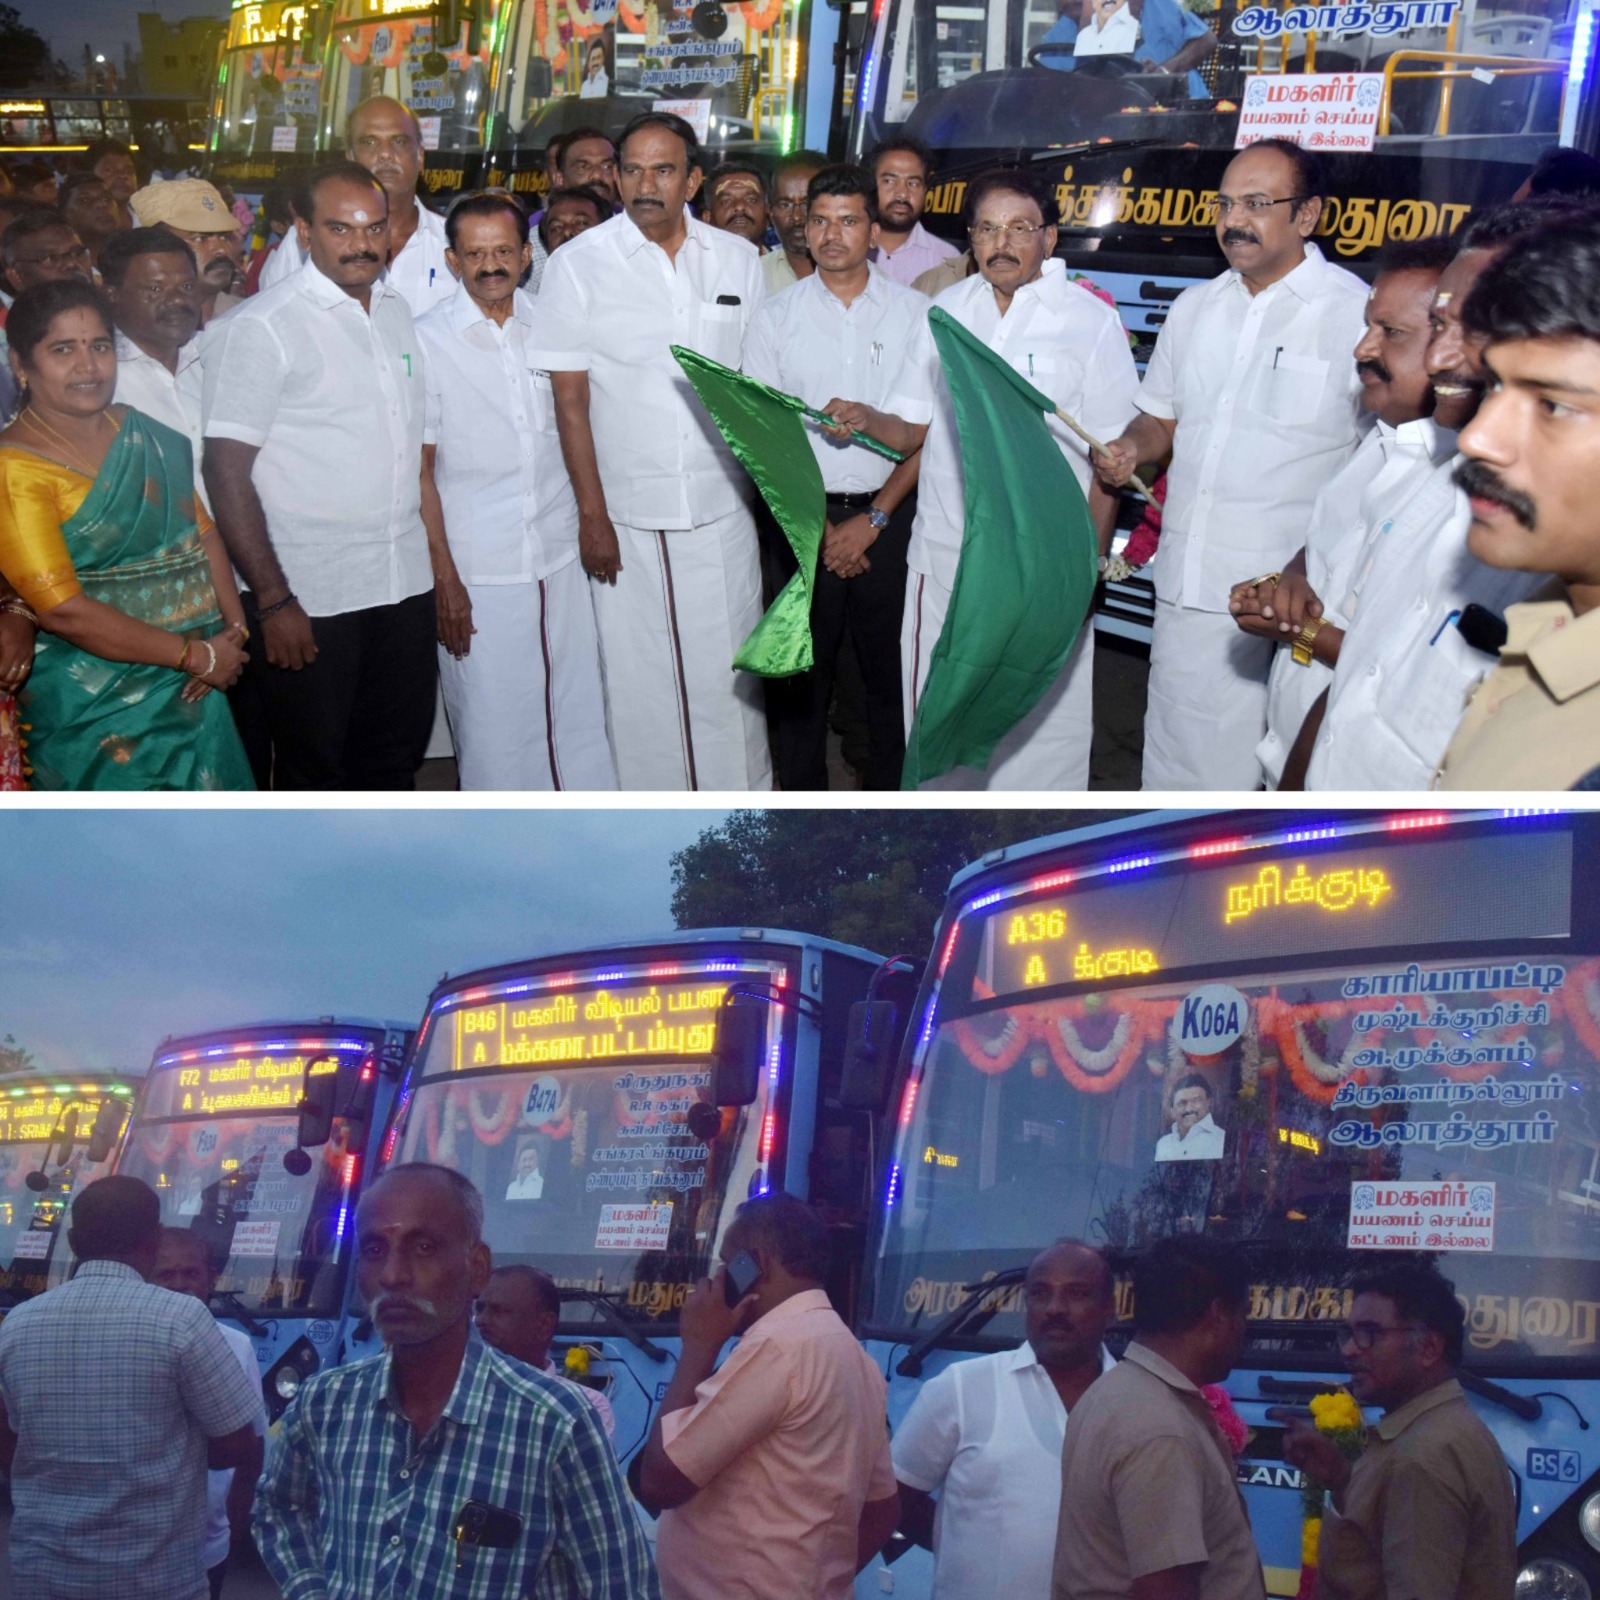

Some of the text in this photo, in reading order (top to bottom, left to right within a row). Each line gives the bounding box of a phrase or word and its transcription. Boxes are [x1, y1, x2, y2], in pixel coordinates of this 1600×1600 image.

[1267, 76, 1359, 103] மகளிர்
[1242, 108, 1374, 125] பயணம் செய்ய
[1308, 131, 1369, 147] இல்லை
[1226, 865, 1391, 925] நரிக்குடி
[1008, 909, 1067, 945] A36
[1024, 955, 1046, 986] A
[1344, 964, 1564, 996] காரியாபட்டி
[464, 1008, 497, 1034] B46
[512, 995, 577, 1029] மகளிர்
[584, 986, 661, 1024] விடியல்
[1181, 995, 1239, 1040] K06A
[1354, 1002, 1547, 1031] முஷ்டக்குறிச்சி
[473, 1041, 487, 1063] A
[1354, 1041, 1532, 1069] அ.முக்குளம்
[526, 1083, 557, 1113] B47A
[1331, 1112, 1557, 1148] ஆலாத்தூர்
[595, 1145, 708, 1161] சங்கரலிங்கபுரம்
[1376, 1183, 1469, 1207] மகளிர்
[612, 1204, 659, 1221] மகளிர்
[1352, 1211, 1491, 1228] பயணம் செய்ய
[1350, 1231, 1490, 1248] கட்டணம் இல்லை
[1455, 1292, 1600, 1349] துரை
[1531, 1453, 1577, 1478] BS6
